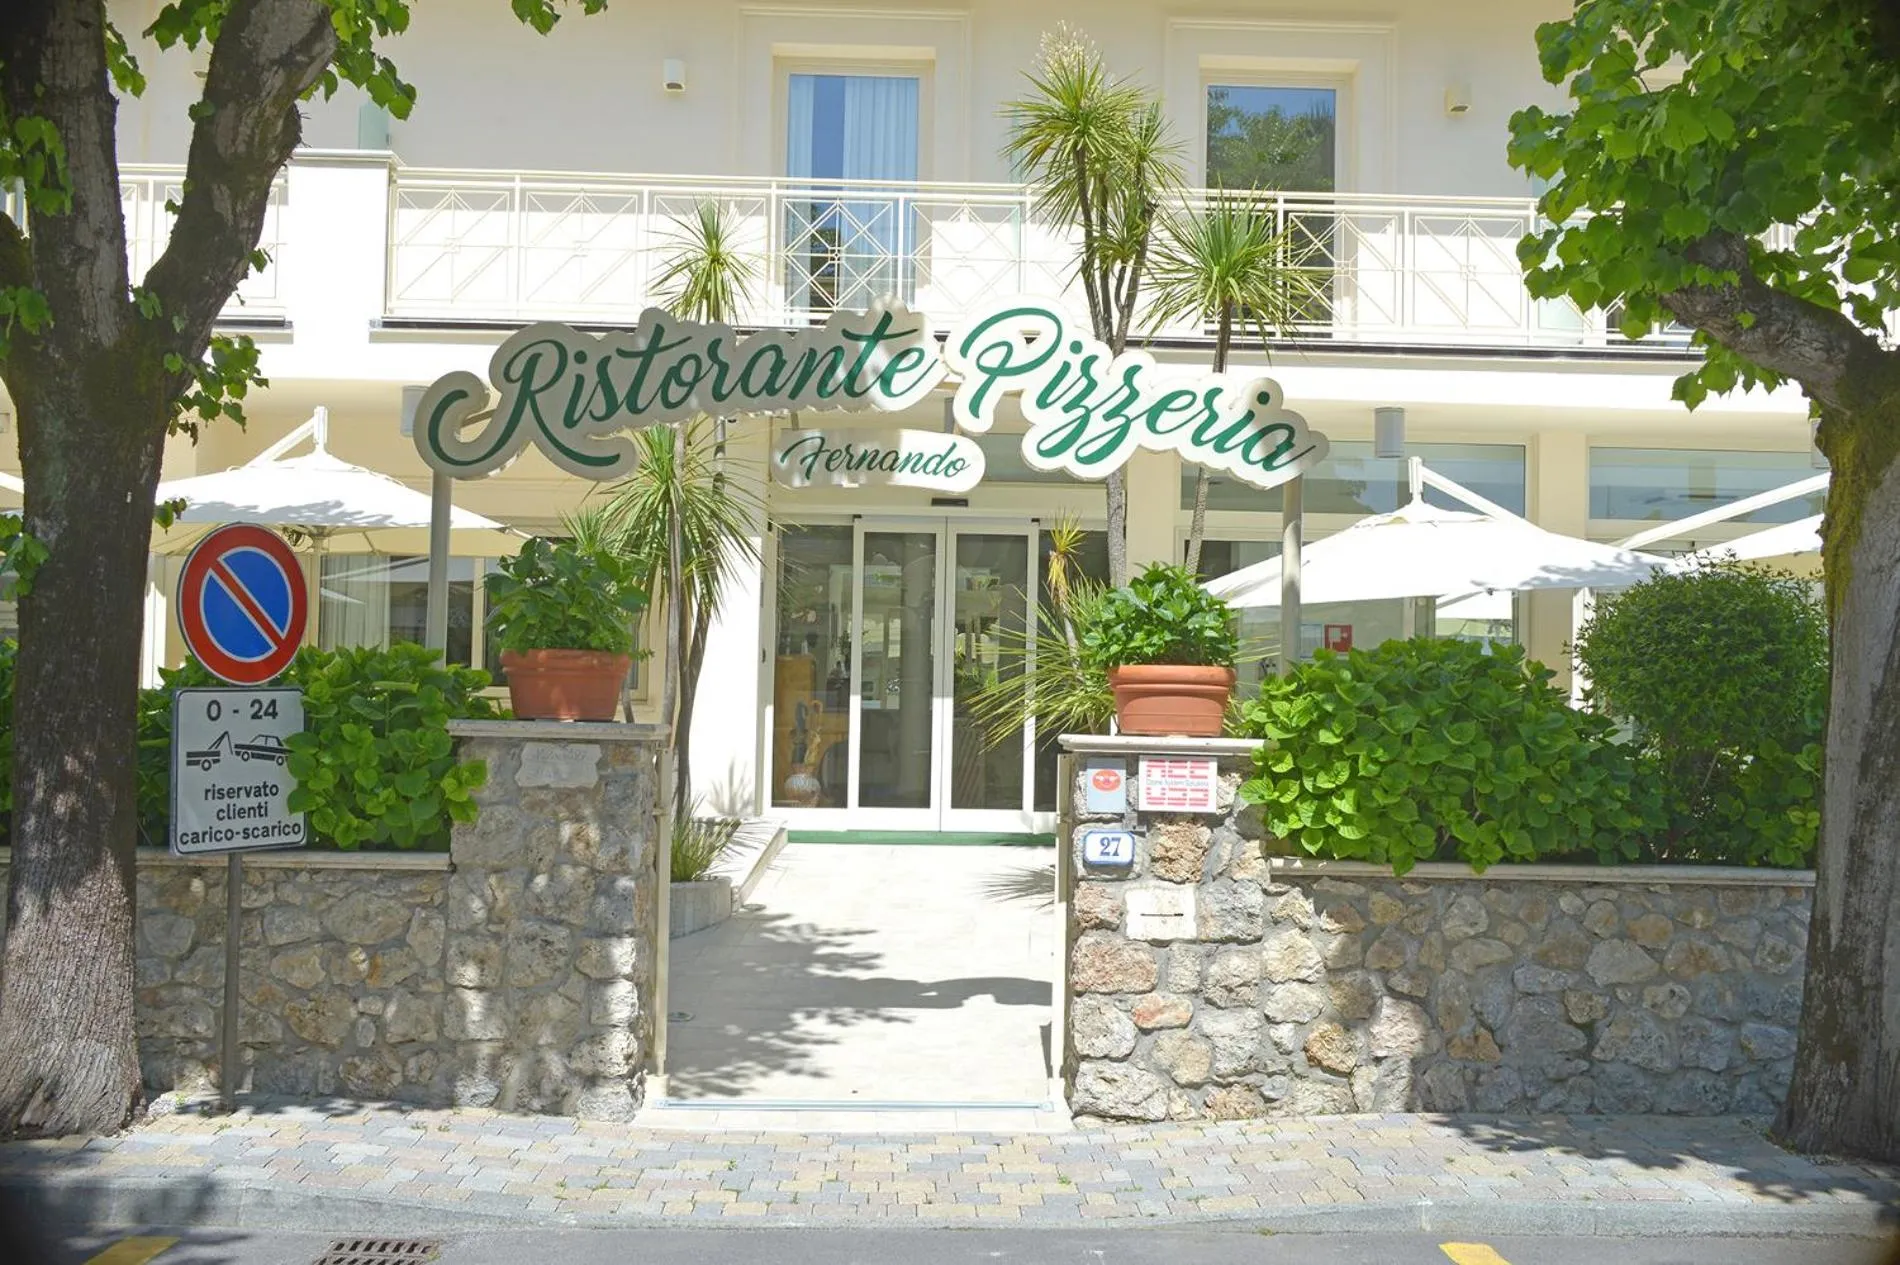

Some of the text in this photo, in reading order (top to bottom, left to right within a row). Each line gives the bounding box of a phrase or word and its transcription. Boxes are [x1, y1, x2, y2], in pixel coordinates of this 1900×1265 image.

[427, 307, 1317, 472] Ristorante Pizzeria
[779, 436, 971, 480] Fernando
[206, 700, 221, 721] 0
[250, 699, 278, 720] 24
[204, 781, 279, 800] riservato
[216, 801, 268, 821] clienti
[180, 820, 301, 845] carico-scarico
[1099, 837, 1122, 857] 27
